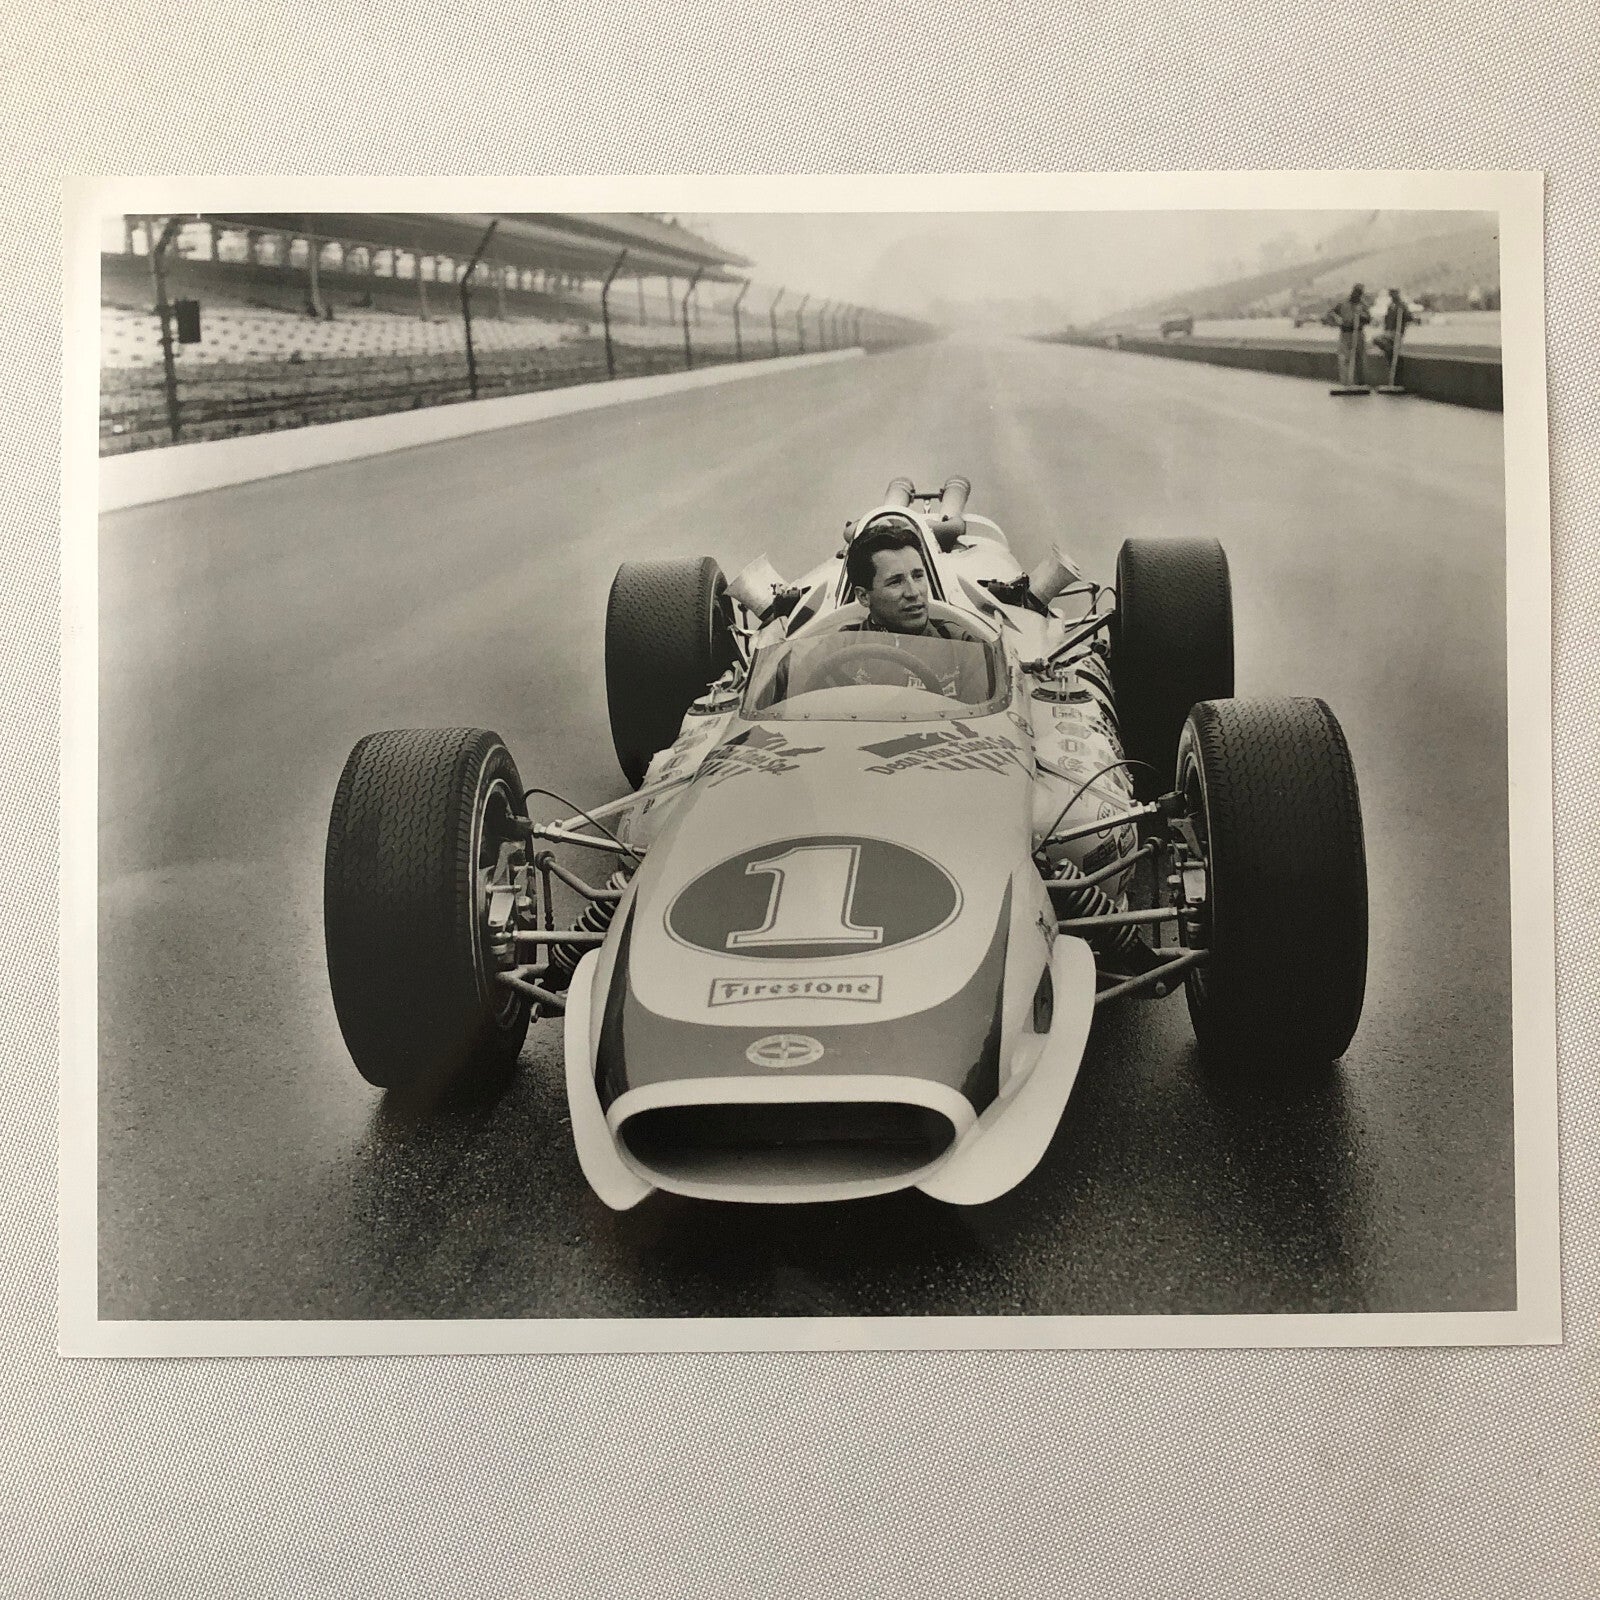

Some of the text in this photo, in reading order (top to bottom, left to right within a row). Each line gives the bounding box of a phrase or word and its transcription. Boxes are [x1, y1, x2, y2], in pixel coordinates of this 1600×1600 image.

[864, 756, 928, 775] Dean
[726, 845, 883, 948] 1
[721, 982, 871, 998] Firestone
